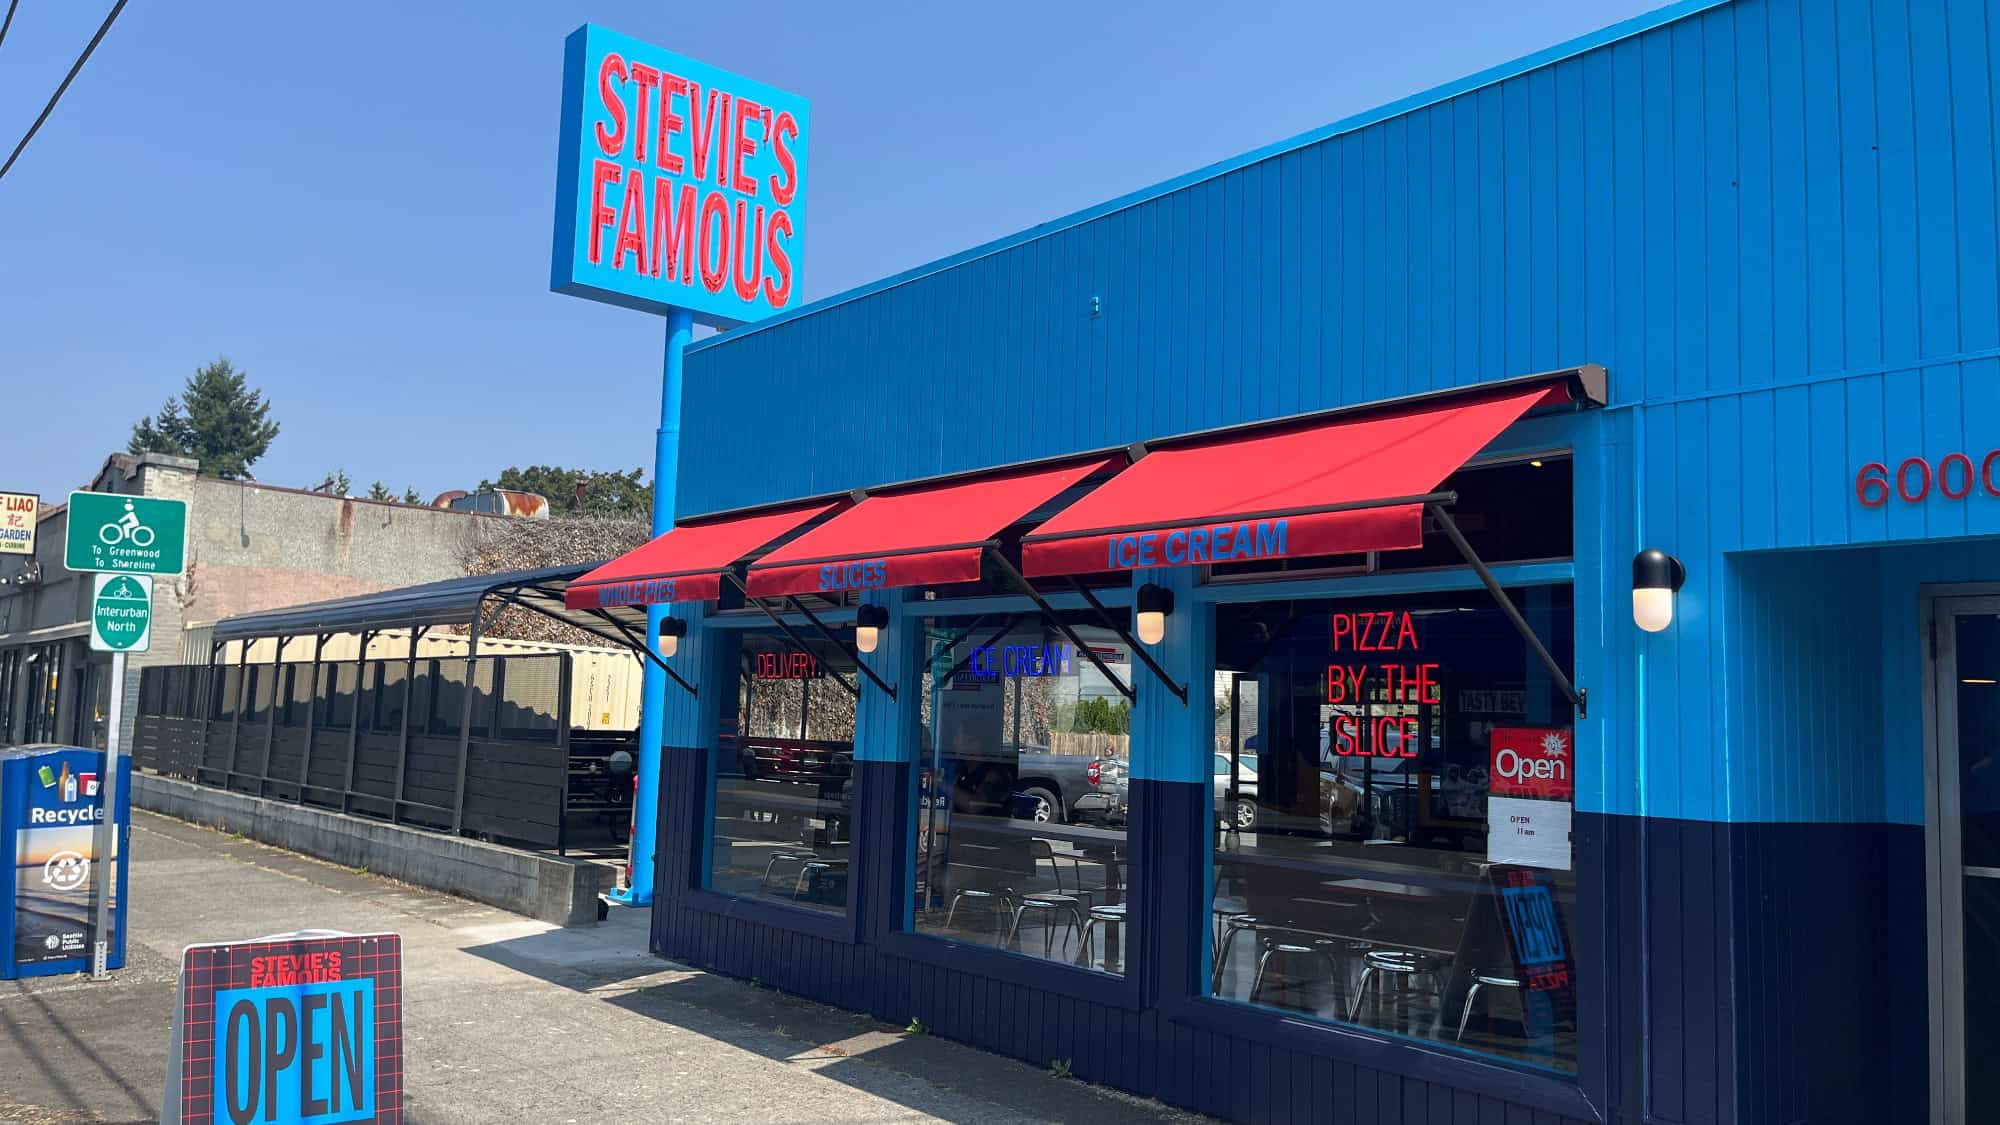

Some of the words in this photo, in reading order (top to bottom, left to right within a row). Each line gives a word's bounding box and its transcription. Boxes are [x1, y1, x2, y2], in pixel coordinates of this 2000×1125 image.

[595, 53, 798, 206] STEVIE'S
[588, 159, 793, 308] FAMOUS
[6, 497, 33, 512] LIAO
[92, 545, 102, 554] To
[110, 546, 160, 558] Greenwood
[1108, 534, 1157, 568] ICE
[1165, 519, 1288, 563] CREAM
[95, 558, 105, 567] To
[112, 559, 156, 570] Shoreline
[819, 560, 886, 590] SLICES
[599, 582, 641, 605] WHOLE
[644, 578, 677, 603] PIES
[97, 605, 148, 618] Interurban
[107, 621, 136, 632] North
[1332, 611, 1418, 651] PIZZA
[757, 652, 817, 679] DELIVERY
[970, 644, 997, 676] ICE
[1003, 643, 1071, 676] CREAM
[1328, 665, 1367, 703] BY
[1380, 663, 1440, 704] THE
[1334, 715, 1417, 758] SLICE
[1495, 748, 1566, 785] Open
[31, 804, 104, 824] Recycle
[1510, 816, 1530, 824] OPEN
[250, 951, 342, 974] STEVIE'S
[250, 967, 342, 989] FAMOUS
[225, 991, 363, 1125] OPEN
